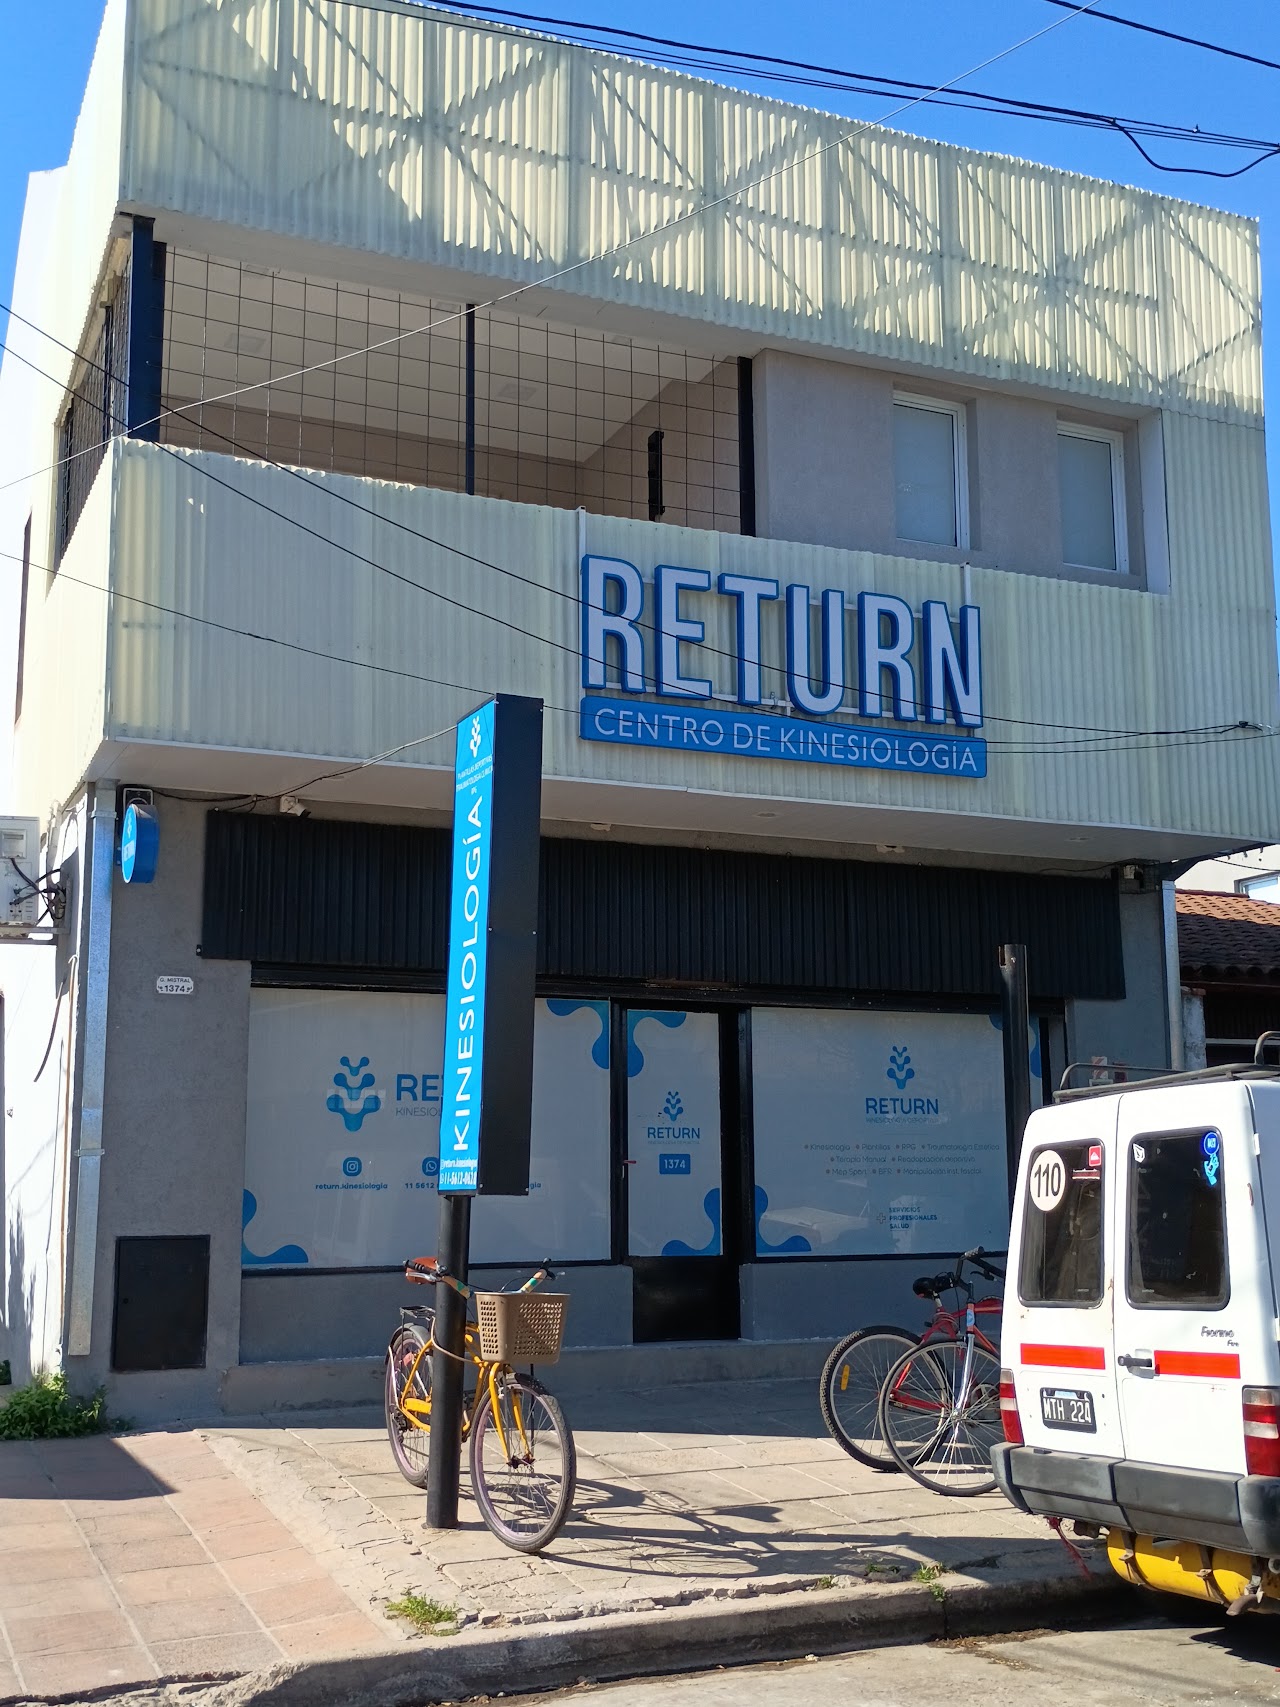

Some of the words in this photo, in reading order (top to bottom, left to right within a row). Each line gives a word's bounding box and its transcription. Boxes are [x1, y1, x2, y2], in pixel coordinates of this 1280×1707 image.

[581, 554, 983, 729] RETURN
[594, 707, 725, 747] CENTRO
[733, 722, 771, 753] DE
[780, 727, 978, 773] KINESIOLOGÍA
[453, 795, 483, 1151] KINESIOLOGÍA
[396, 1074, 444, 1101] RE
[865, 1097, 939, 1115] RETURN
[647, 1127, 700, 1139] RETURN
[664, 1159, 686, 1169] 1374
[836, 1155, 861, 1164] Terapia
[862, 1155, 887, 1163] Manual
[315, 1182, 388, 1191] return.kinesiologia
[1034, 1162, 1061, 1198] 110
[1043, 1397, 1065, 1421] MTH
[1070, 1400, 1092, 1424] 224
